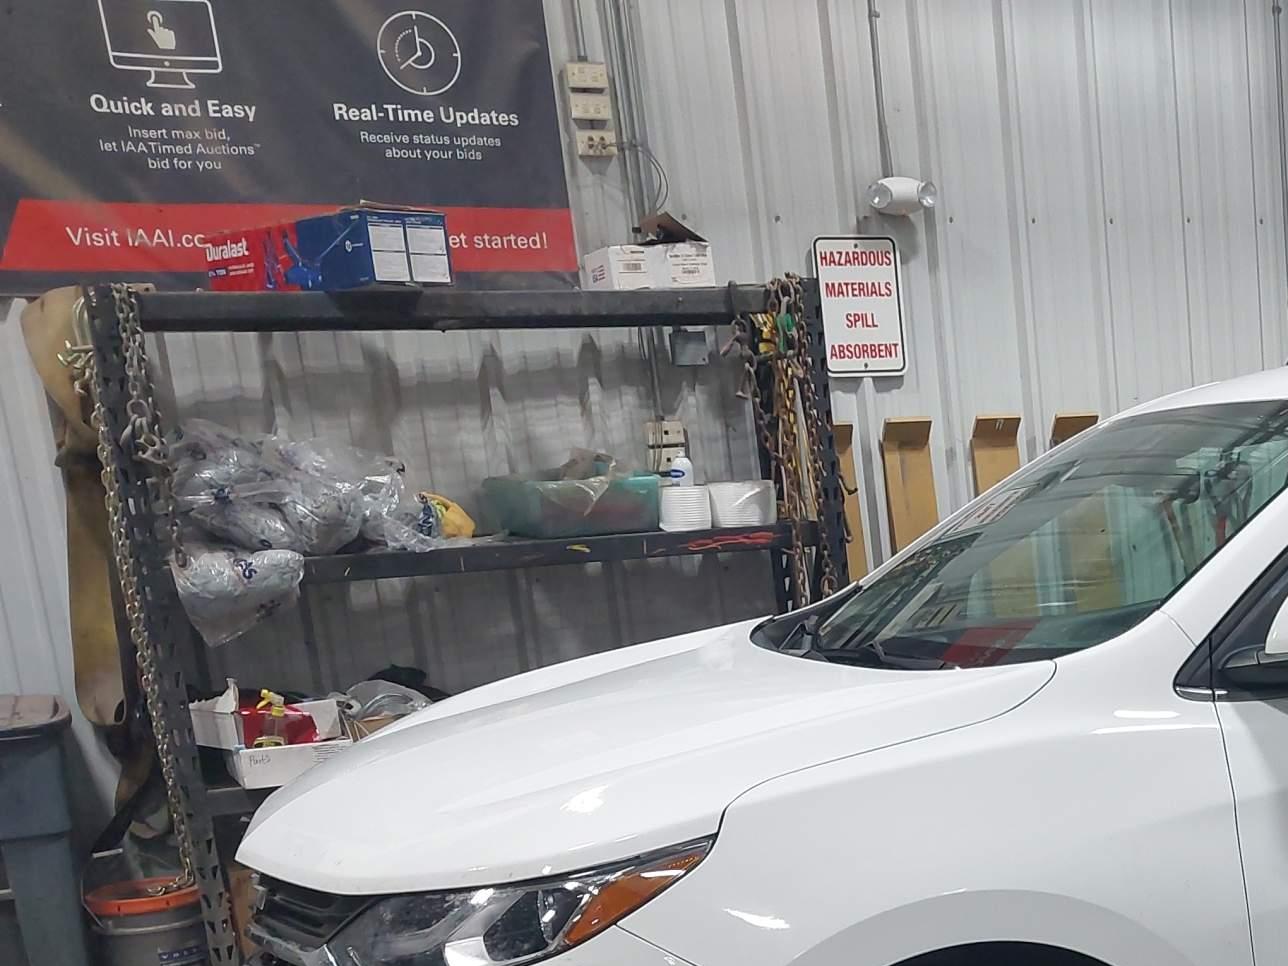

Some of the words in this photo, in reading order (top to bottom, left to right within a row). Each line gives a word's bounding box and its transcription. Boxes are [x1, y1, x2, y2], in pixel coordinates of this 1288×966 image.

[89, 93, 155, 116] Quick
[161, 100, 201, 117] and
[207, 100, 256, 122] Easy
[332, 103, 434, 122] Real-Time
[439, 106, 520, 127] Updates
[128, 125, 168, 139] Insert
[171, 130, 201, 140] max
[204, 128, 231, 141] bid,
[360, 131, 410, 144] Receive
[413, 133, 450, 145] status
[453, 135, 501, 147] updates
[99, 139, 118, 152] let
[121, 140, 148, 153] IAA
[149, 142, 193, 155] Timed
[385, 147, 422, 159] about
[424, 149, 453, 160] your
[456, 148, 482, 160] bids
[147, 157, 170, 169] bid
[173, 157, 192, 169] for
[194, 159, 223, 172] you
[65, 226, 121, 247] Visit
[448, 232, 469, 249] et
[473, 231, 549, 249] started!
[204, 237, 250, 262] Duralast
[819, 250, 893, 267] HAZARDOUS
[825, 281, 893, 298] MATERIALS
[845, 312, 879, 329] SPILL
[829, 343, 899, 360] ABSORBENT
